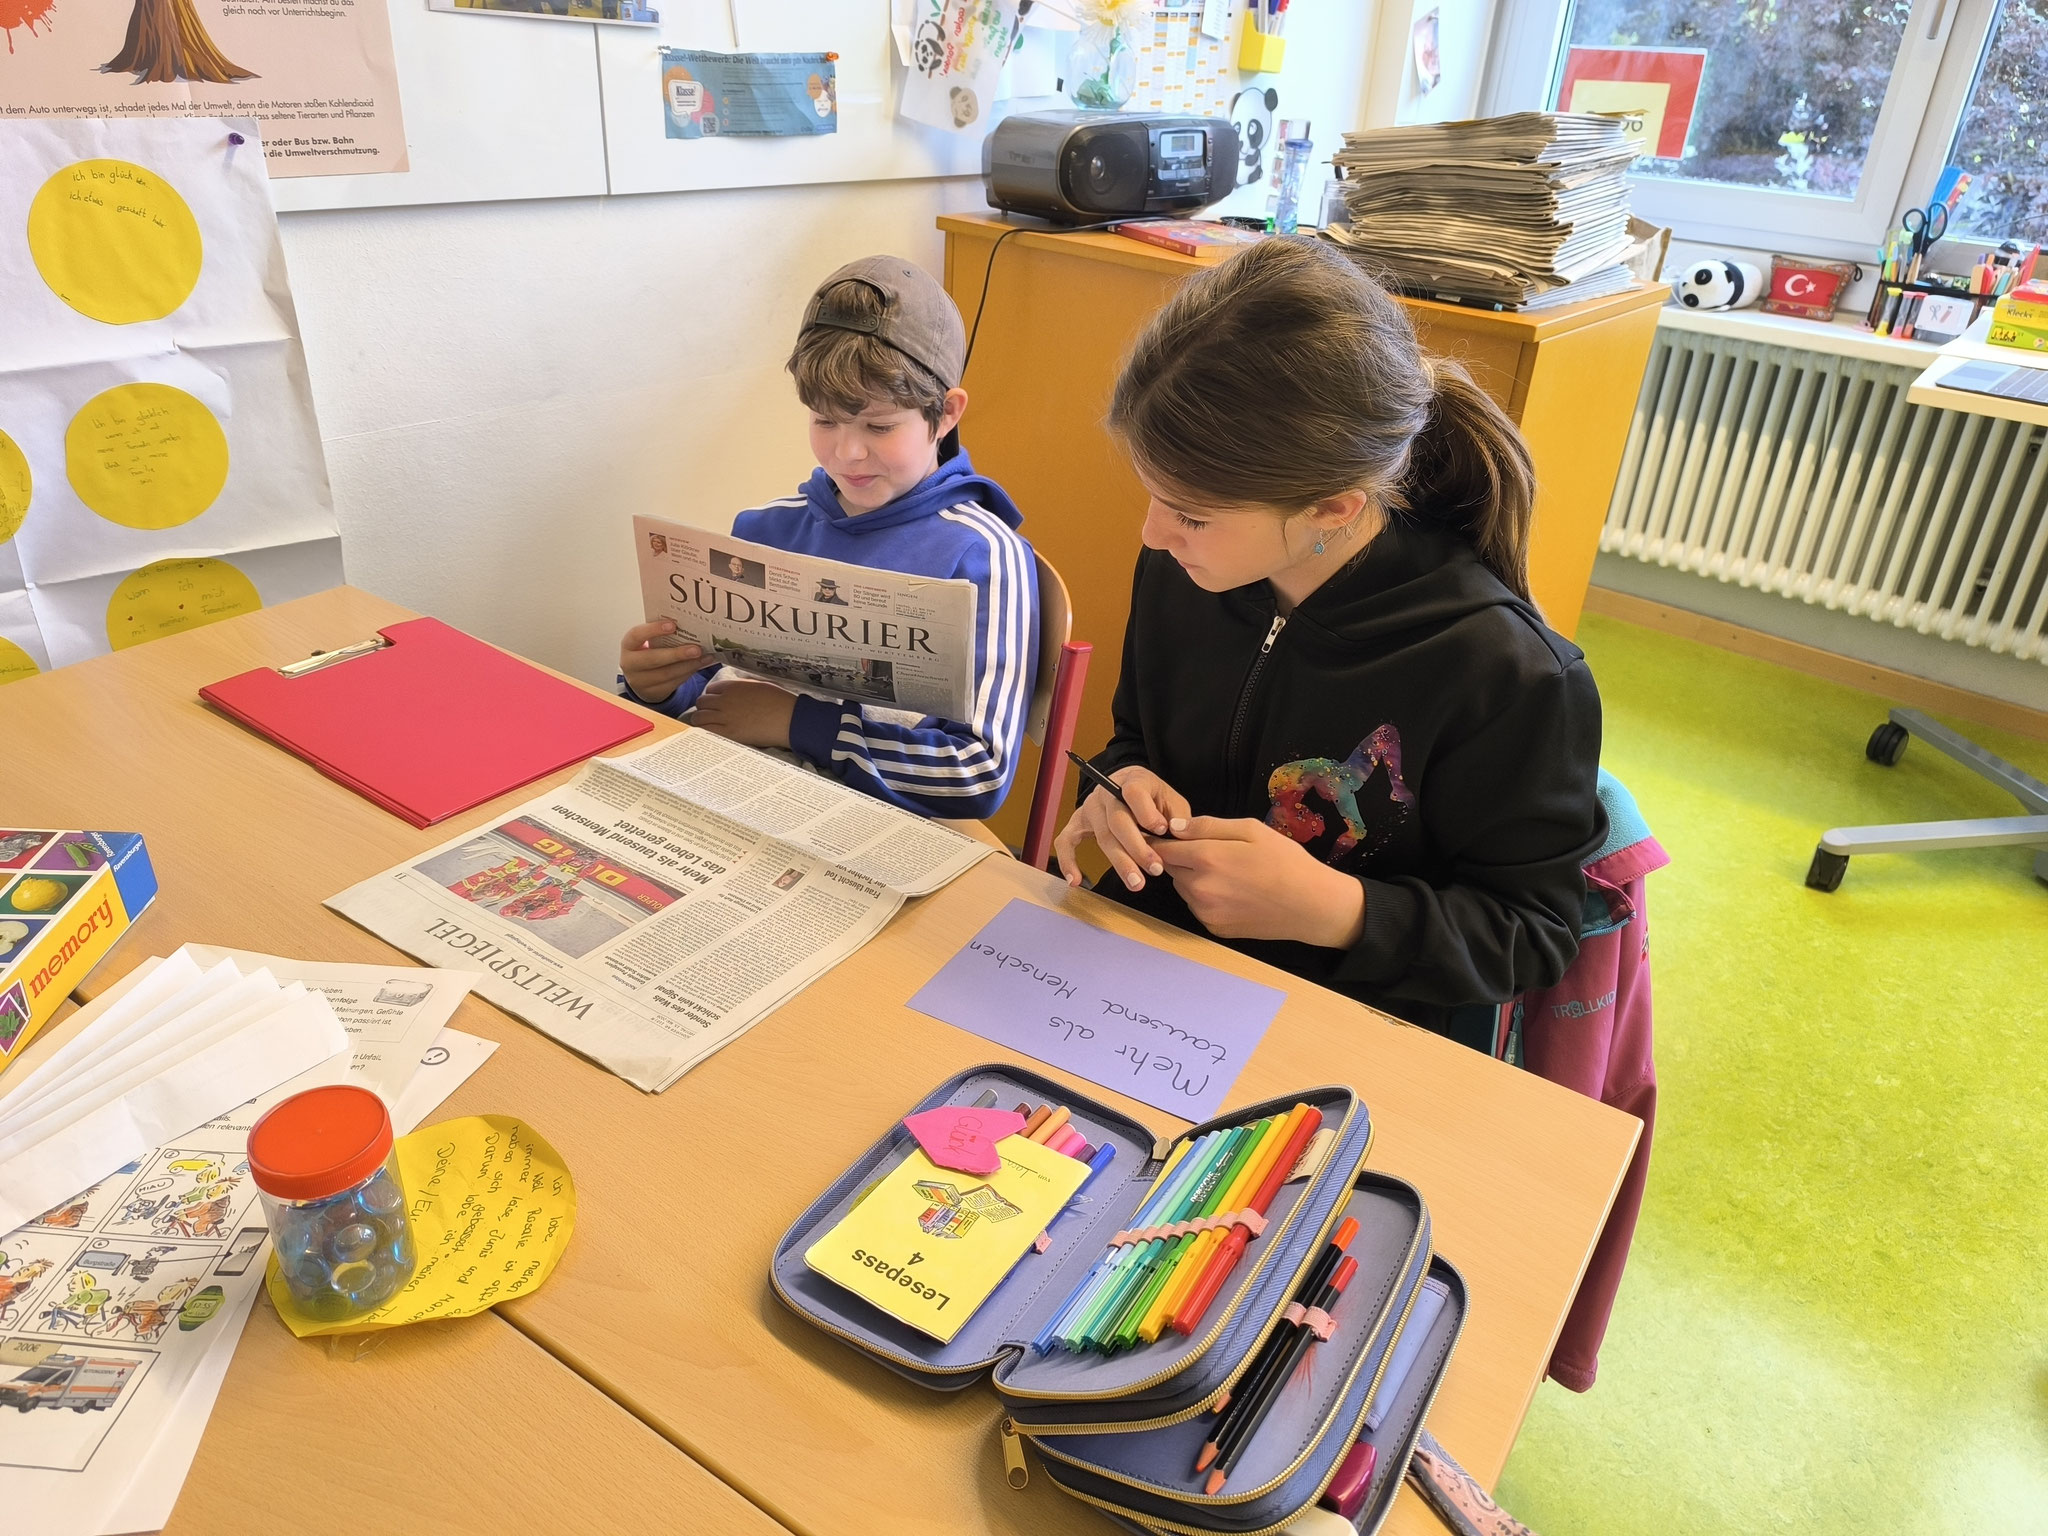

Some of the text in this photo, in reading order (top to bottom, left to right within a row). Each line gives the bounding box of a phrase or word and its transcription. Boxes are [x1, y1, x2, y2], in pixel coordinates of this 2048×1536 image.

[223, 5, 246, 16] gleich
[248, 7, 267, 15] noch
[282, 8, 347, 19] Unterrichtsbeginn.
[733, 55, 744, 64] Die
[5, 98, 374, 115] dem Auto unterwegs ist, schadet jedes Mal der Umwelt, denn die Motoren stoßen Kohlendioxid
[271, 112, 296, 120] seltene
[297, 111, 328, 120] Tierarten
[330, 110, 344, 120] und
[345, 109, 375, 119] Pflanzen
[269, 147, 380, 158] die Umweltverschmutzung.
[272, 137, 354, 147] oder Bus bzw. Bahn
[91, 169, 105, 180] bin
[69, 190, 81, 201] ich
[669, 573, 938, 655] SÜDKURIER
[546, 804, 612, 836] Menschen
[90, 831, 116, 858] Ravensburger
[113, 838, 143, 872] Ravensburger
[605, 832, 659, 859] tausend
[610, 818, 727, 876] das Leben gerettet
[653, 854, 680, 869] als
[672, 863, 713, 884] Mehr
[821, 869, 883, 899] Frau täuscht Tod
[28, 898, 114, 999] memory
[417, 916, 603, 1020] WELTSPIEGEL
[650, 994, 712, 1028] Sender des Wals
[653, 983, 722, 1021] schickt kein Signal
[970, 940, 1228, 1066] tausend Menschen
[1049, 1014, 1210, 1096] Mehr als
[426, 1142, 455, 1187] Deine
[518, 1143, 533, 1182] immer
[138, 1181, 166, 1193] MIAU
[487, 1170, 502, 1193] sich
[552, 1175, 562, 1196] Ich
[402, 1132, 499, 1292] Darum lobe ich meinen
[907, 1251, 925, 1266] 4
[456, 1265, 477, 1284] und
[505, 1260, 540, 1292] meinen
[851, 1248, 951, 1312] Lesepass
[13, 1342, 42, 1352] 200€
